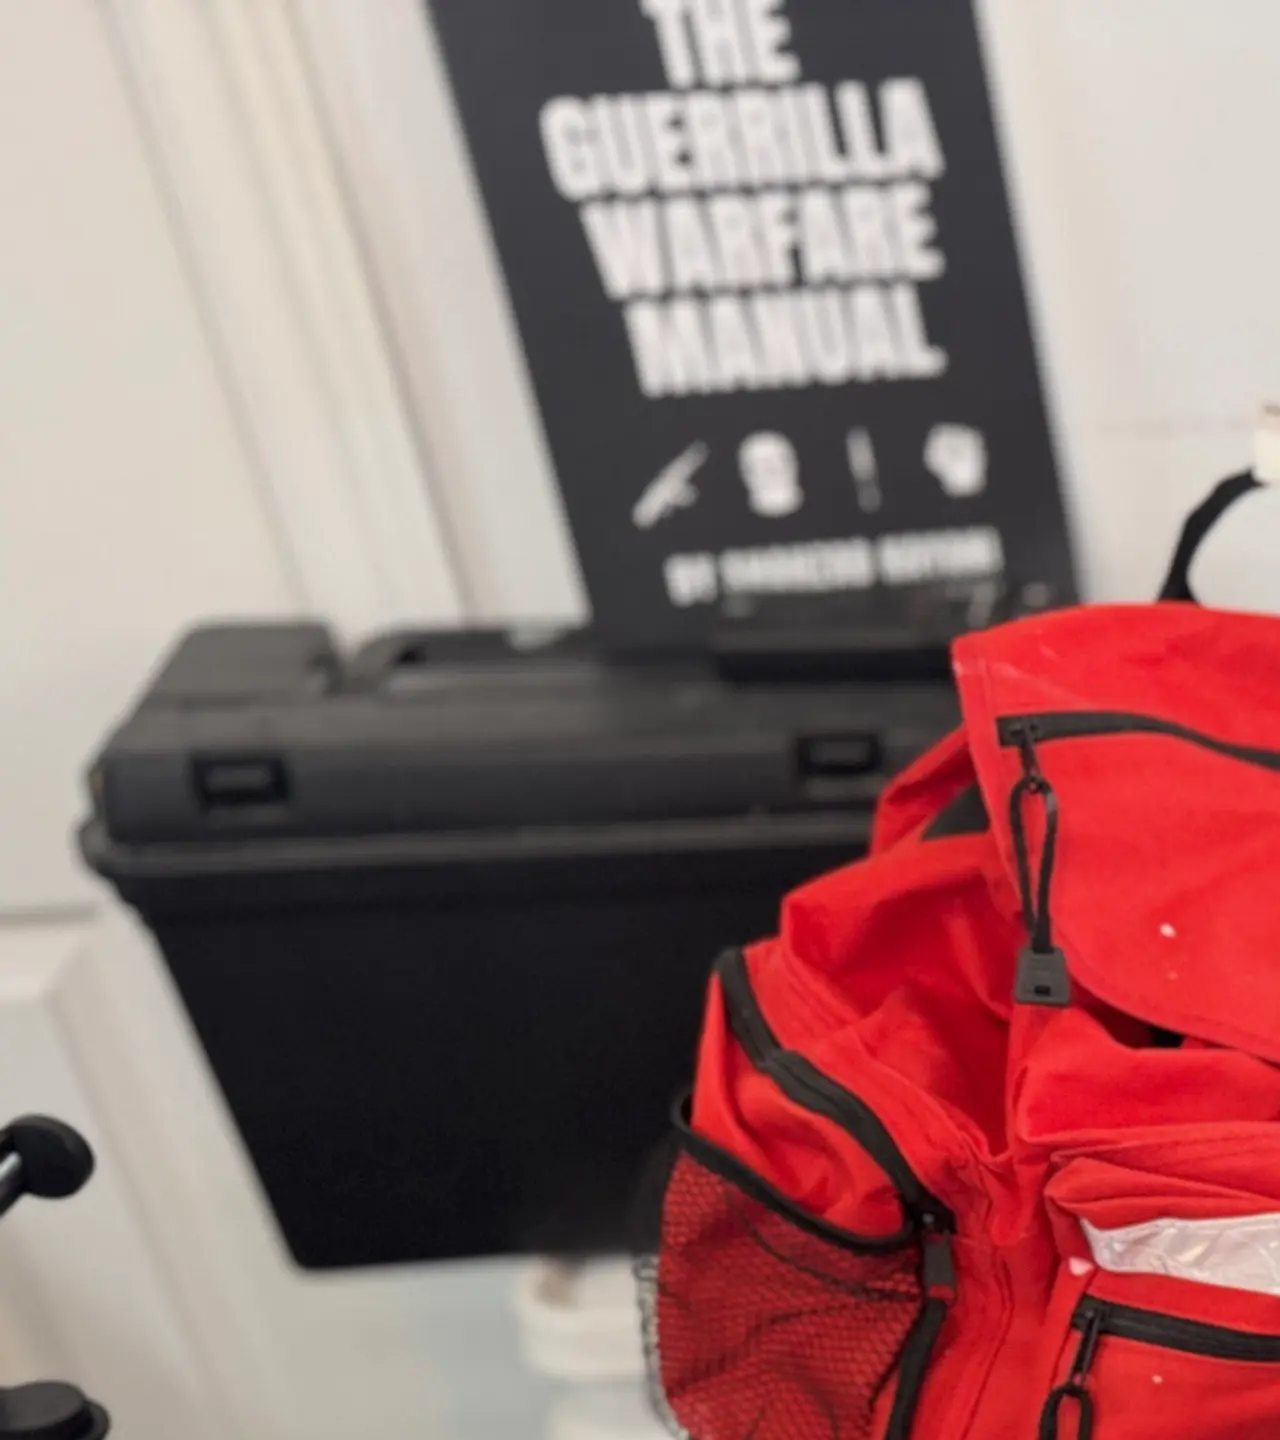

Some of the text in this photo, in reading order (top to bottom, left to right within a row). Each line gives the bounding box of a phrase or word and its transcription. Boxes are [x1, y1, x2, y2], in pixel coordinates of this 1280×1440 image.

[640, 0, 801, 89] THE
[539, 77, 946, 200] GUERRILLA
[580, 181, 946, 300] WARFARE
[622, 282, 948, 398] MANUAL
